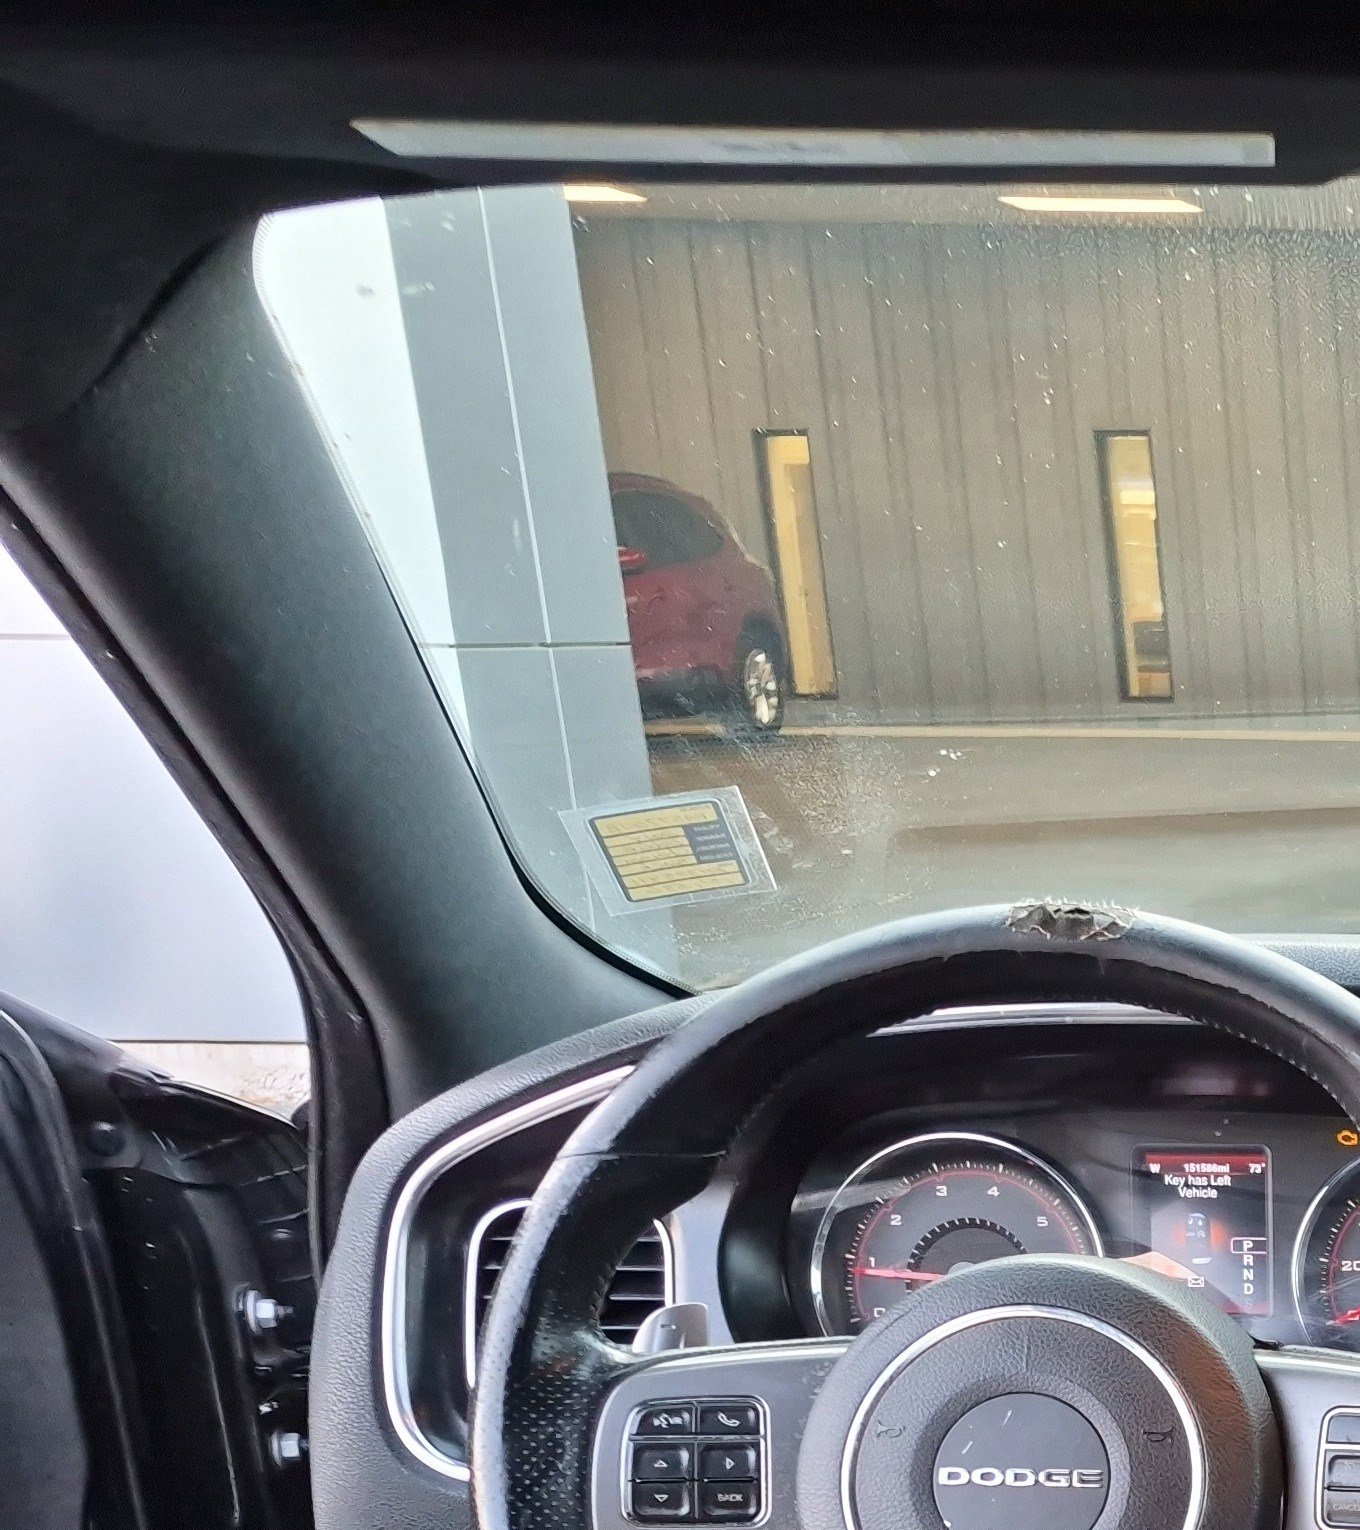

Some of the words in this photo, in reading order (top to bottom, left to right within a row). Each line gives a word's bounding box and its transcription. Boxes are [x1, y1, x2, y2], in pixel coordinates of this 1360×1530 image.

[1149, 1163, 1161, 1173] W
[1164, 1175, 1185, 1187] Key
[1188, 1175, 1208, 1186] has
[1210, 1175, 1231, 1186] Left
[936, 1186, 947, 1196] 3
[987, 1186, 999, 1196] 4
[1178, 1187, 1218, 1198] Vehicle
[890, 1214, 902, 1226] 2
[1037, 1216, 1048, 1226] 5
[1243, 1241, 1253, 1252] P
[869, 1257, 875, 1266] 1
[1243, 1255, 1253, 1266] R
[1243, 1269, 1253, 1280] N
[1243, 1283, 1253, 1294] D
[937, 1466, 1103, 1488] DODGE
[717, 1493, 743, 1502] BACK
